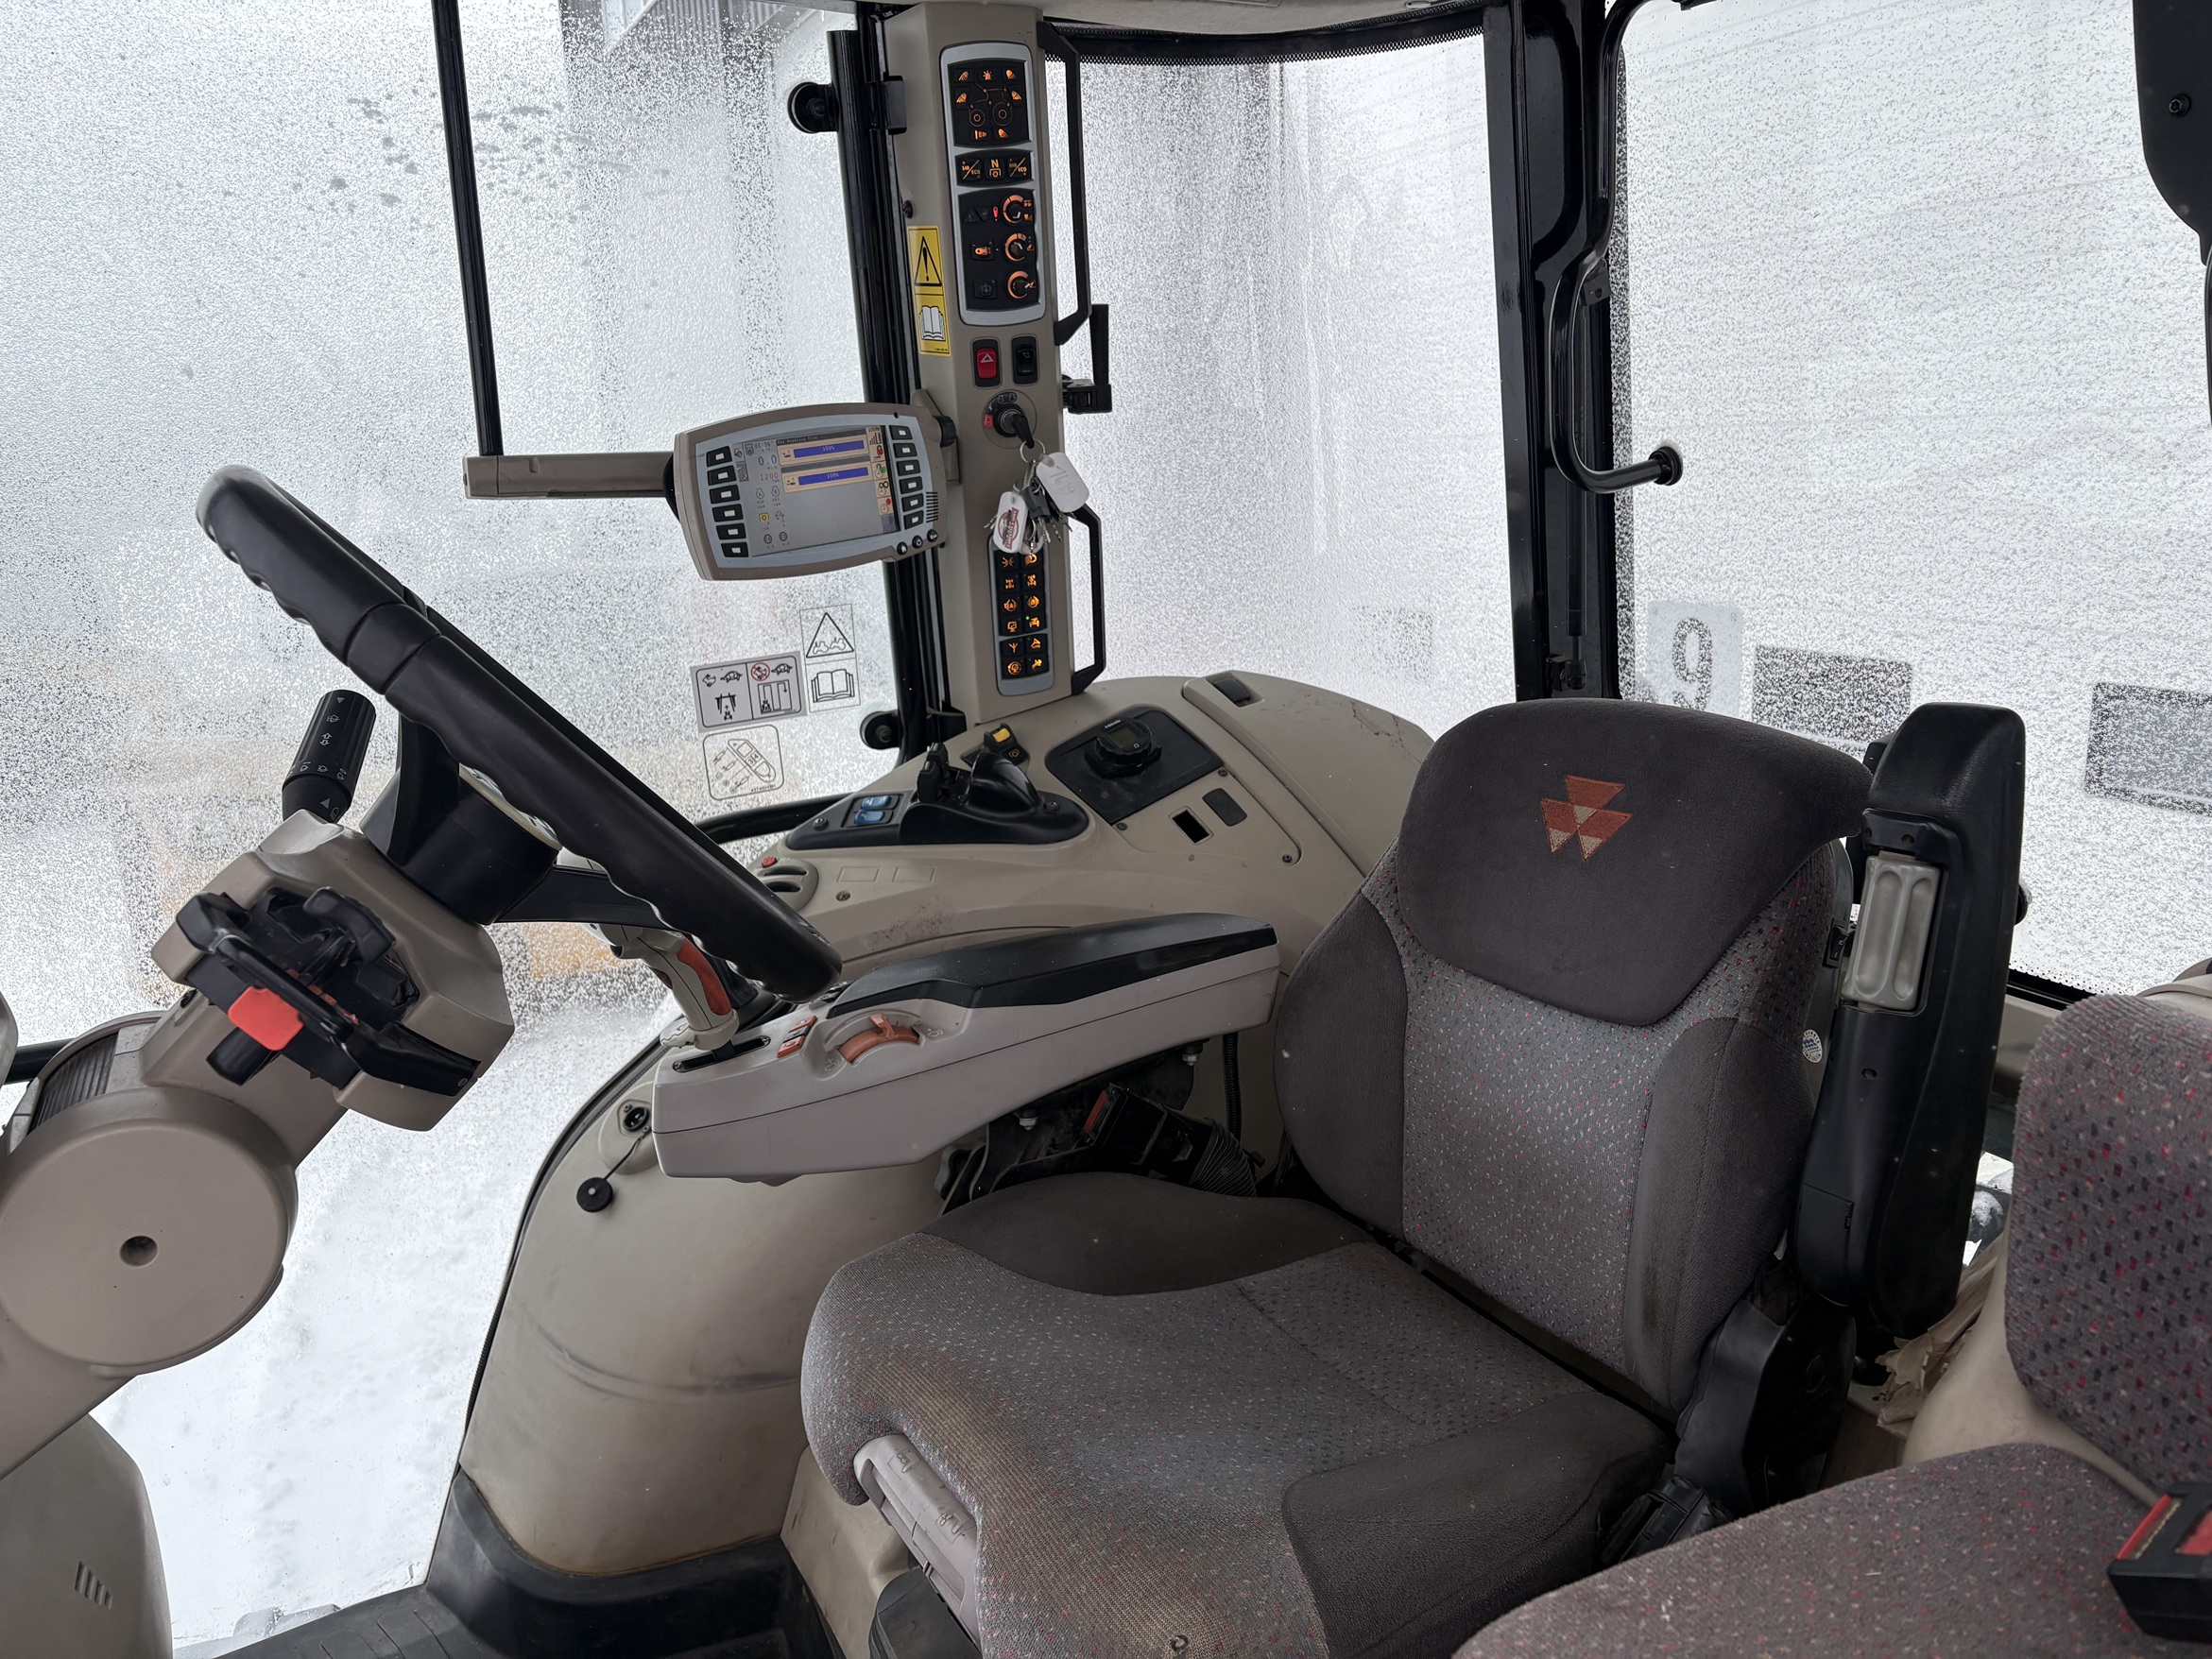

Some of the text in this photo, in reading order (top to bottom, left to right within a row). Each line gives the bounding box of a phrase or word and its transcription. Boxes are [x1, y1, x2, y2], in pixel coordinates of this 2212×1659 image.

[990, 159, 1000, 168] N
[758, 454, 777, 466] 0.0
[760, 472, 779, 481] 1200
